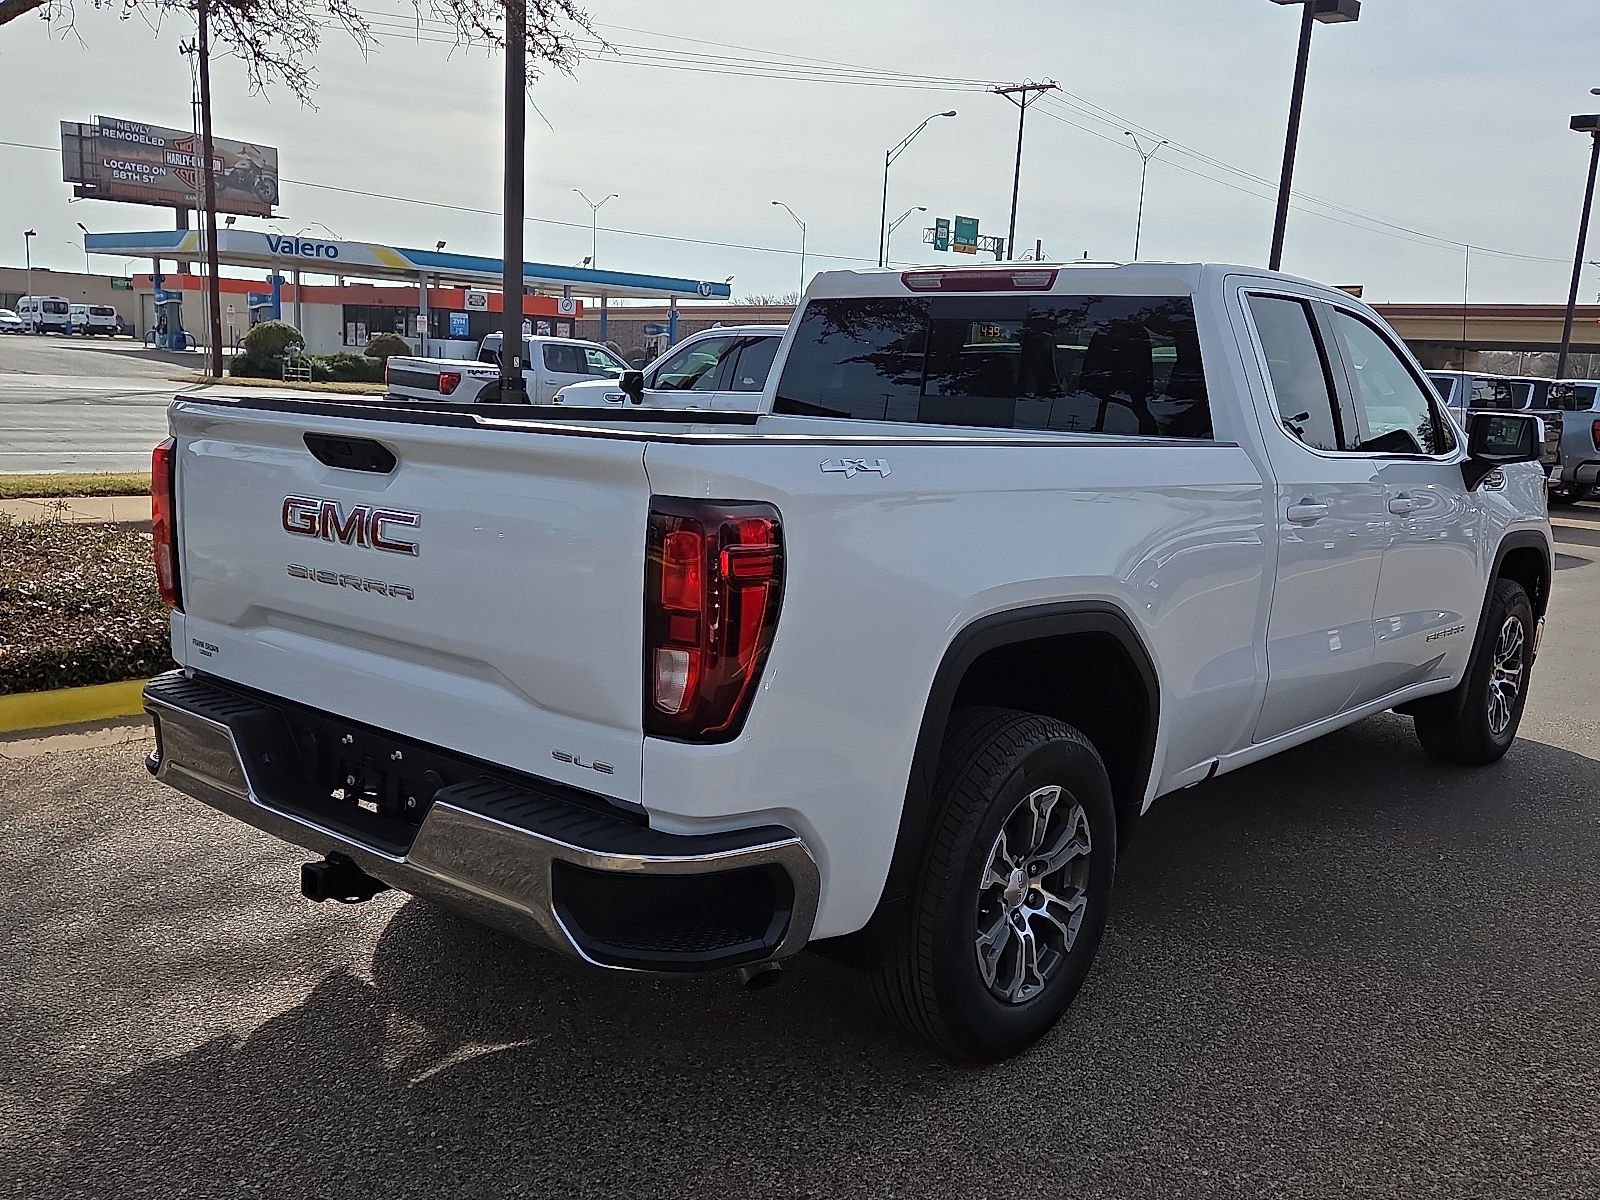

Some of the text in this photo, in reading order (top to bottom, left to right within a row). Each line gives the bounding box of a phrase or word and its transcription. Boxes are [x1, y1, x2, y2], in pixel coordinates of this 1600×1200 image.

[102, 128, 165, 147] REMODELED
[116, 121, 151, 134] NEWLY
[103, 159, 166, 176] LOCATED ON
[142, 174, 157, 184] ST.
[265, 234, 339, 259] Valero
[282, 493, 421, 557] GMC
[287, 563, 415, 601] SIERRA
[551, 749, 614, 775] SLE
